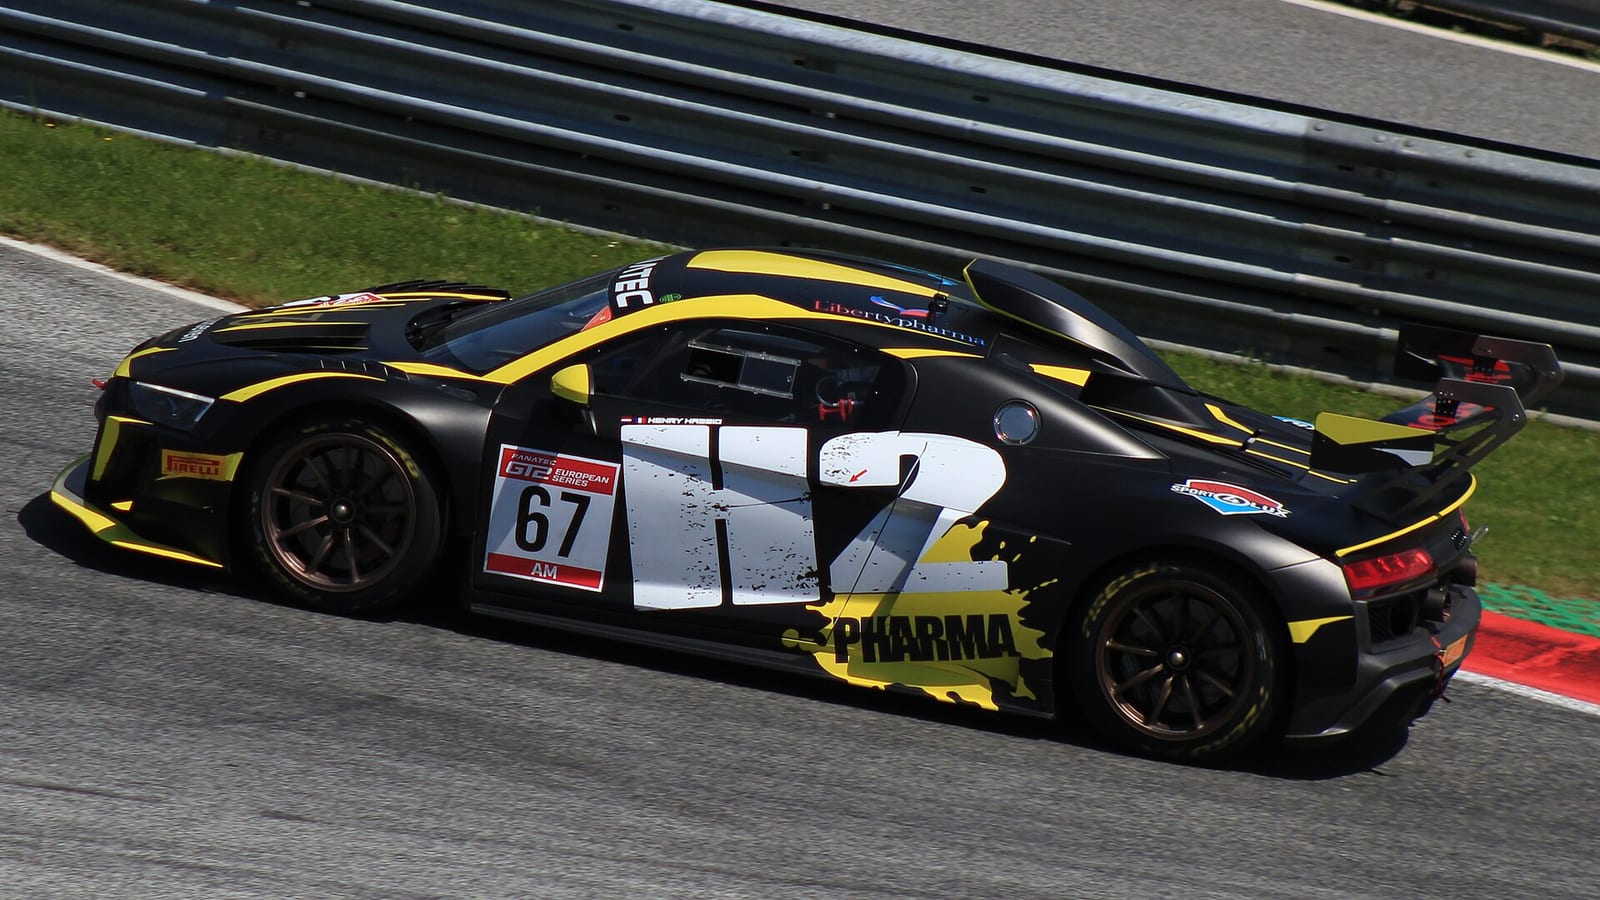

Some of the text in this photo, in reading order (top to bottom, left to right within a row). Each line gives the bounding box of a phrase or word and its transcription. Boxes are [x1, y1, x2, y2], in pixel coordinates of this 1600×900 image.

[814, 299, 986, 346] Libertypharma
[647, 416, 684, 424] HENRY
[166, 455, 220, 475] PIRELLI
[511, 453, 557, 466] FANATEC
[505, 460, 553, 480] GT2
[554, 468, 610, 484] EUROPEAN
[551, 474, 588, 487] SERIES
[1170, 483, 1216, 498] SPORT
[1249, 501, 1292, 518] LUX
[515, 485, 592, 558] 67
[531, 562, 558, 580] AM
[832, 613, 1020, 664] PHARMA
